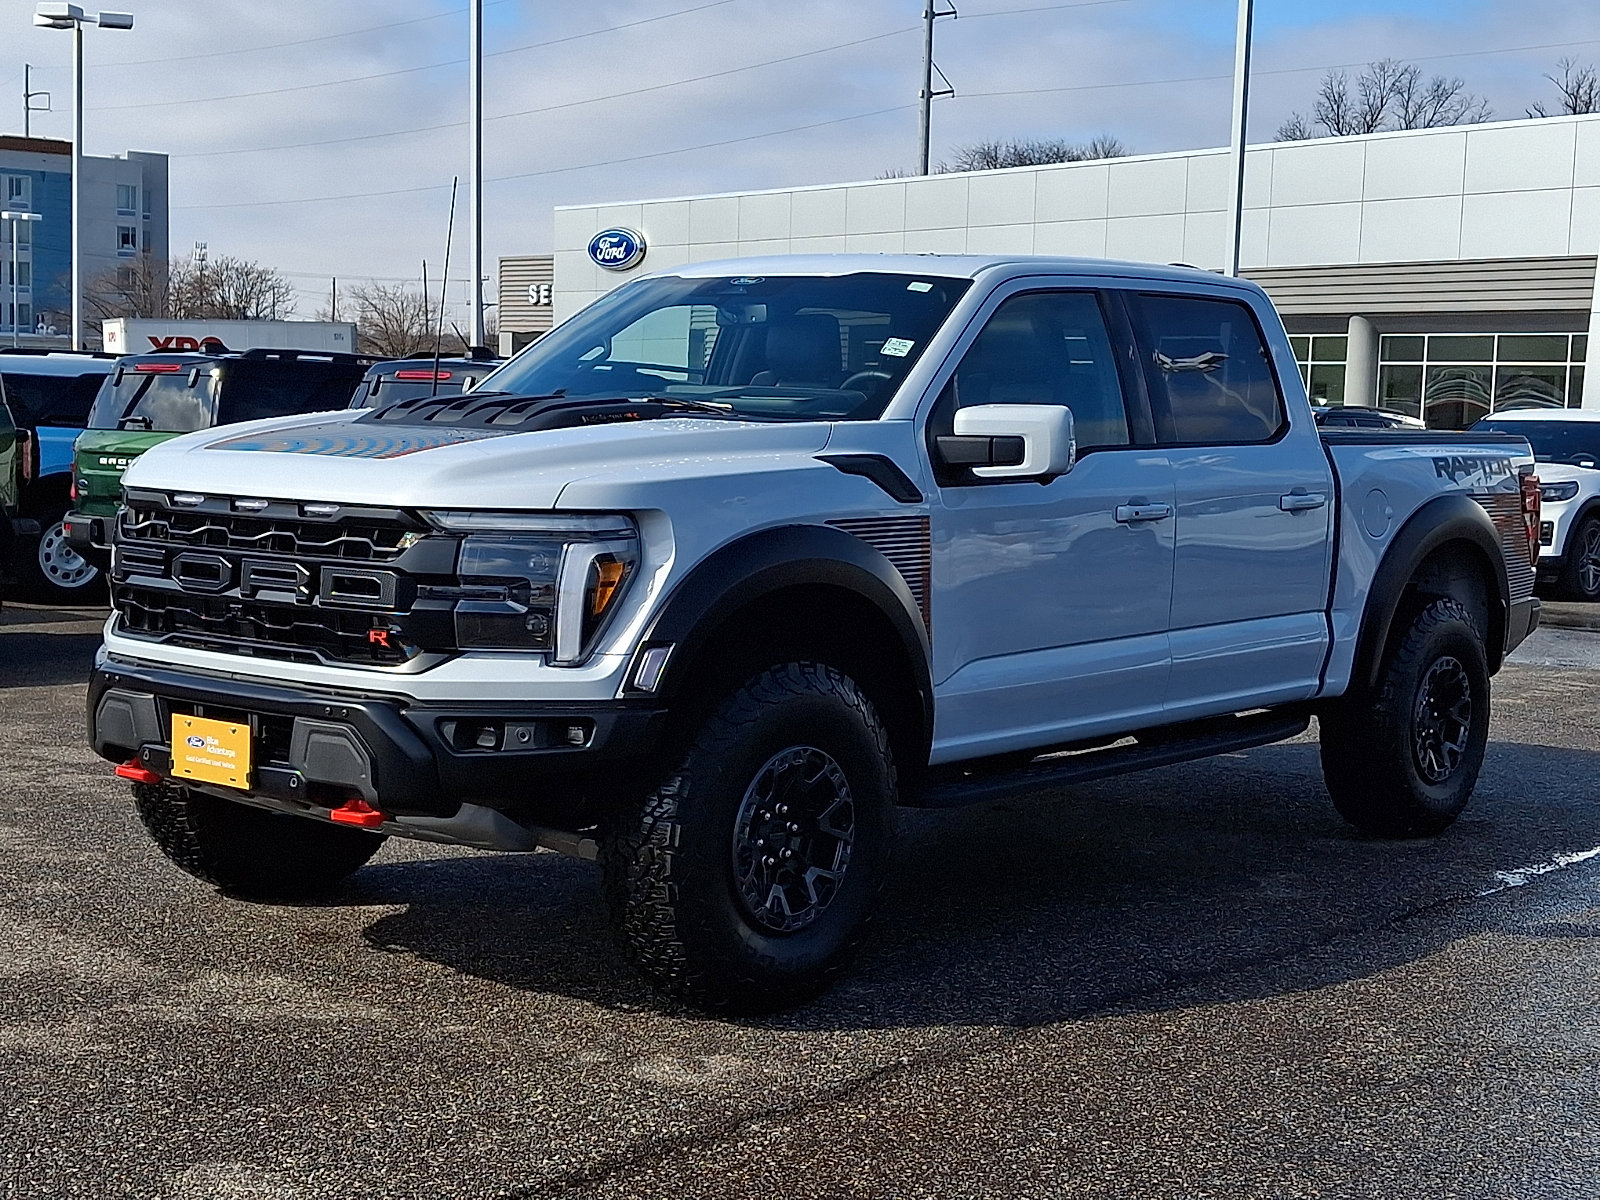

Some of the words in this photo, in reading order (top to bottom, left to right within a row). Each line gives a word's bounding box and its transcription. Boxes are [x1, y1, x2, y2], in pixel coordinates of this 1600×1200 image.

[596, 236, 627, 260] Ford
[528, 284, 554, 304] SE
[1431, 456, 1517, 486] RAPTOR
[115, 545, 400, 609] FORD
[369, 630, 390, 648] R
